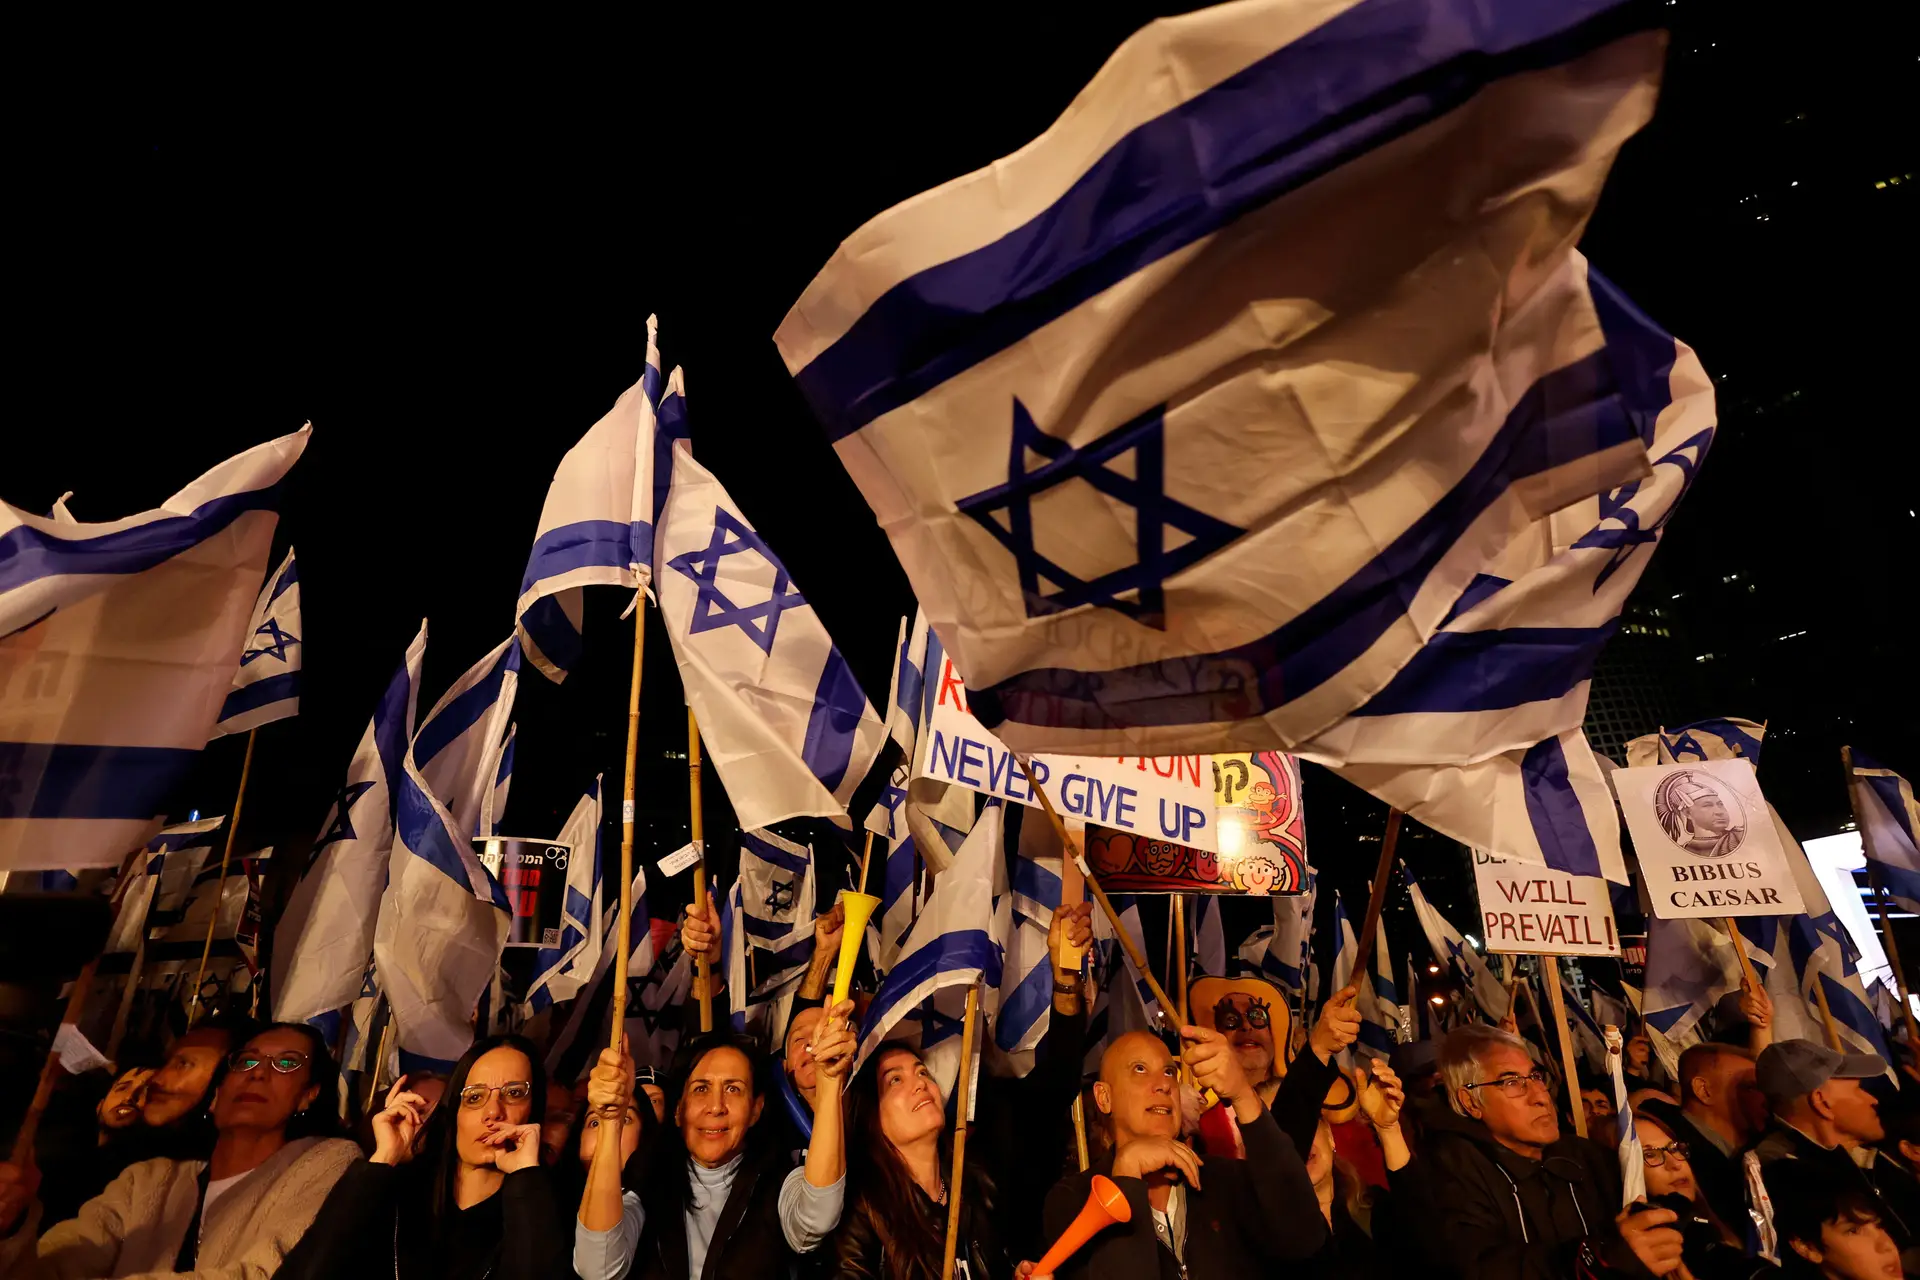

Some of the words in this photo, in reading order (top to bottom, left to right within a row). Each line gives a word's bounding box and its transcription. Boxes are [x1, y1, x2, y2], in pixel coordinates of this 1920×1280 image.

[930, 730, 1050, 802] NEVER
[1060, 773, 1138, 828] GIVE
[1159, 798, 1206, 842] UP
[1671, 861, 1762, 882] BIBIUS
[1496, 880, 1586, 905] WILL
[1670, 887, 1783, 908] CAESAR
[1485, 912, 1615, 950] PREVAIL!
